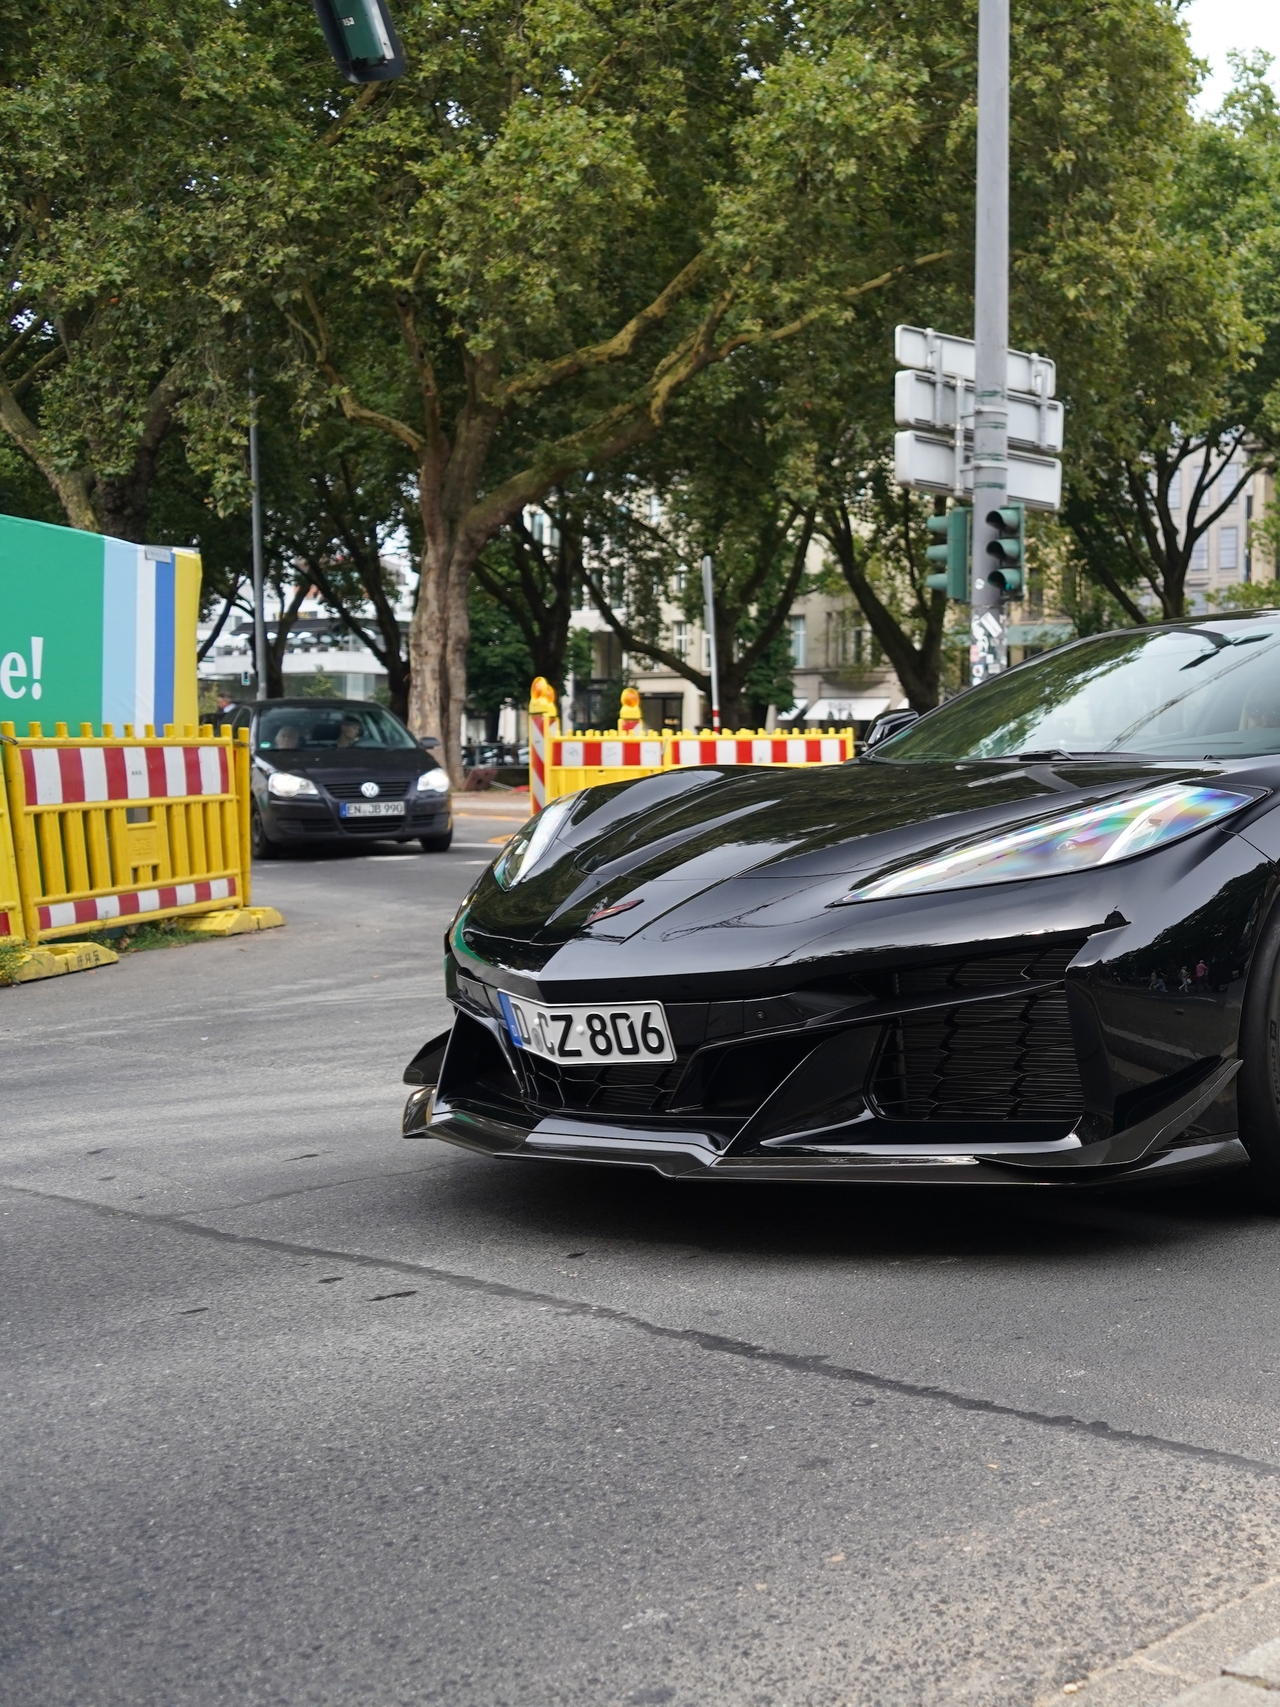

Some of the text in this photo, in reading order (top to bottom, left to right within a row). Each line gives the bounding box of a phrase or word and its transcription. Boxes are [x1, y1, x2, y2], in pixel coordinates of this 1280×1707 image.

[384, 803, 403, 814] 990
[510, 1002, 531, 1045] D
[585, 1011, 665, 1056] 806
